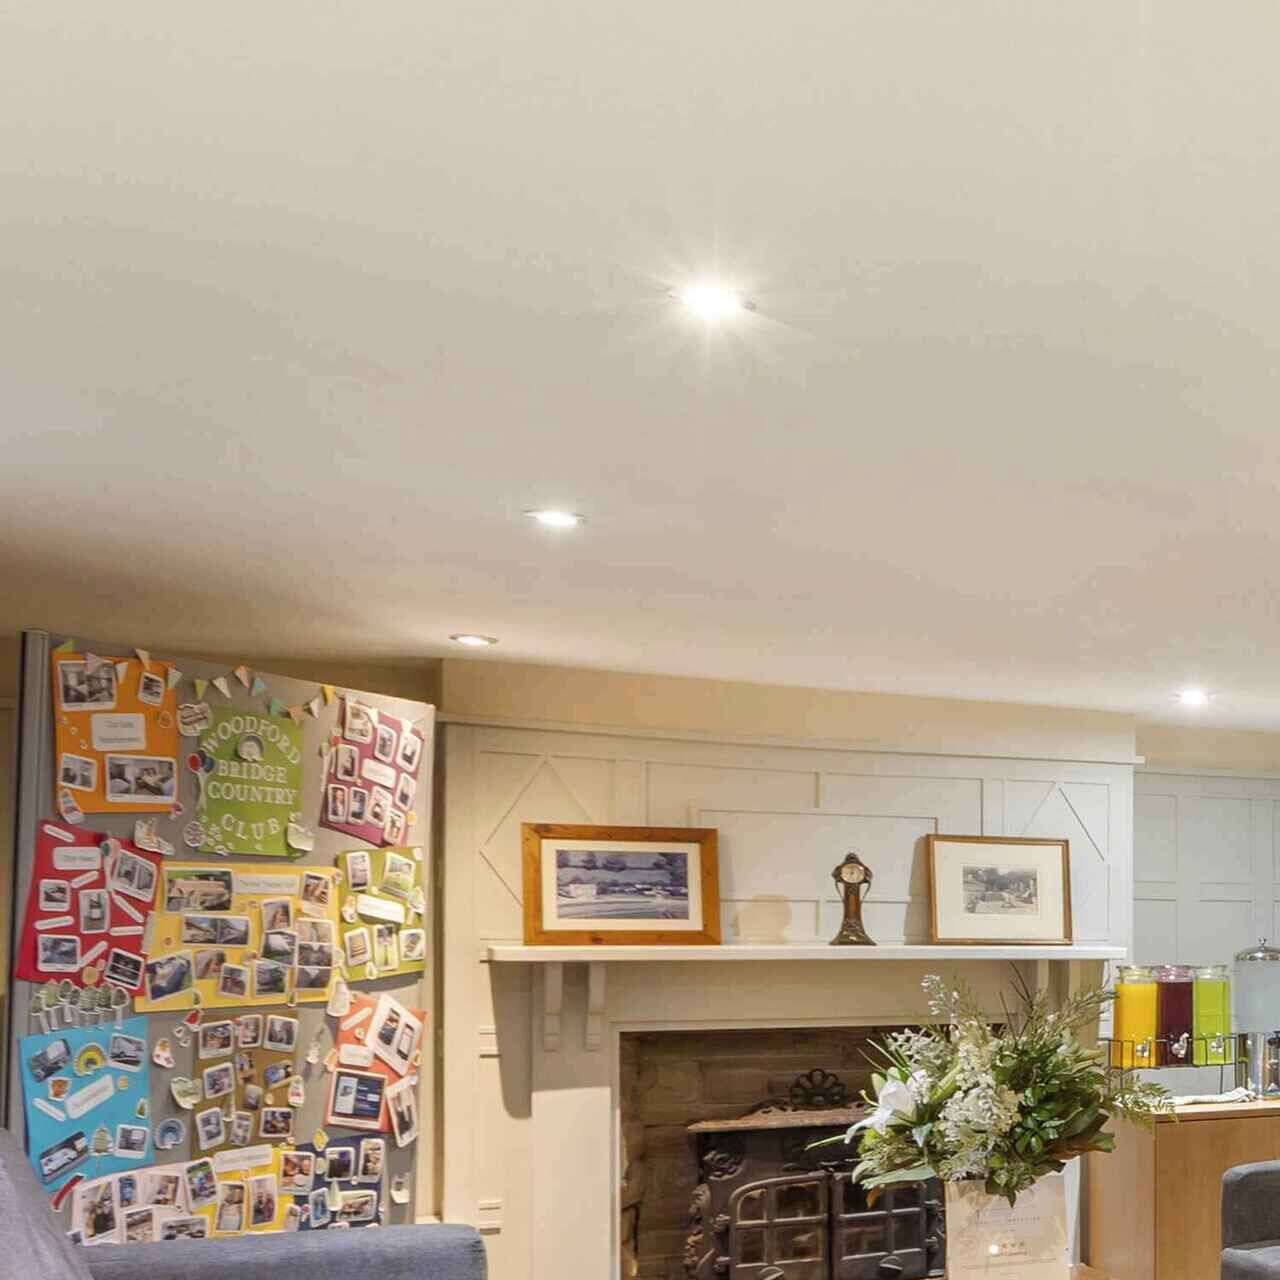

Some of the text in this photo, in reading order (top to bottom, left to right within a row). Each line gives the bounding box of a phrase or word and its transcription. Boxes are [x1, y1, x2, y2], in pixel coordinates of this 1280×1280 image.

[201, 716, 301, 765] WOODFORD
[217, 760, 288, 785] BRIDGE
[207, 781, 299, 806] COUNTRY
[221, 813, 281, 841] CLUB
